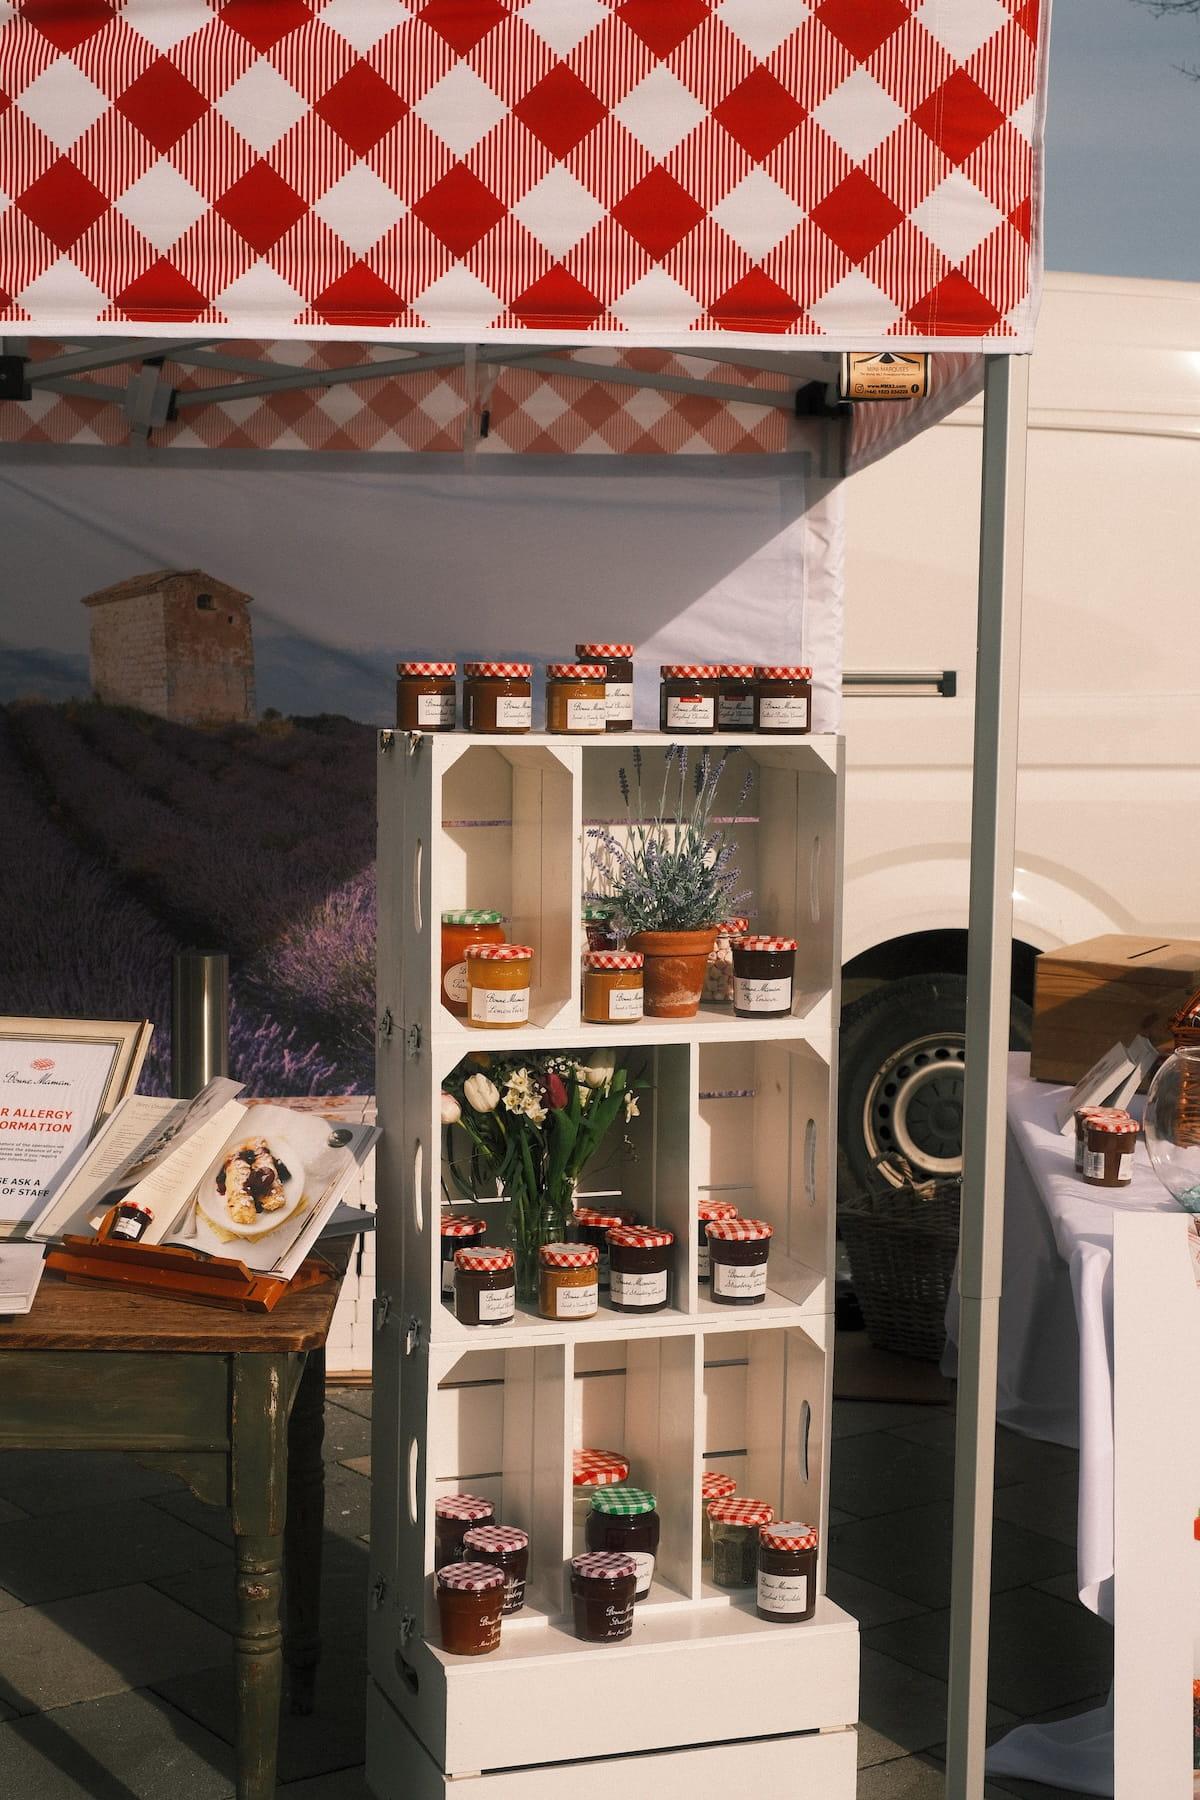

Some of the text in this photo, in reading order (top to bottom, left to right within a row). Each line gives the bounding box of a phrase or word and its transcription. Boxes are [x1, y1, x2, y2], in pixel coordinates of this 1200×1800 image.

[487, 992, 507, 1003] Bonne
[3, 1071, 72, 1087] Bonne Maman
[13, 1107, 72, 1120] ALLERGY
[10, 1178, 32, 1186] ASK
[2, 1187, 50, 1197] OF STAFF
[605, 1605, 625, 1617] Bonne
